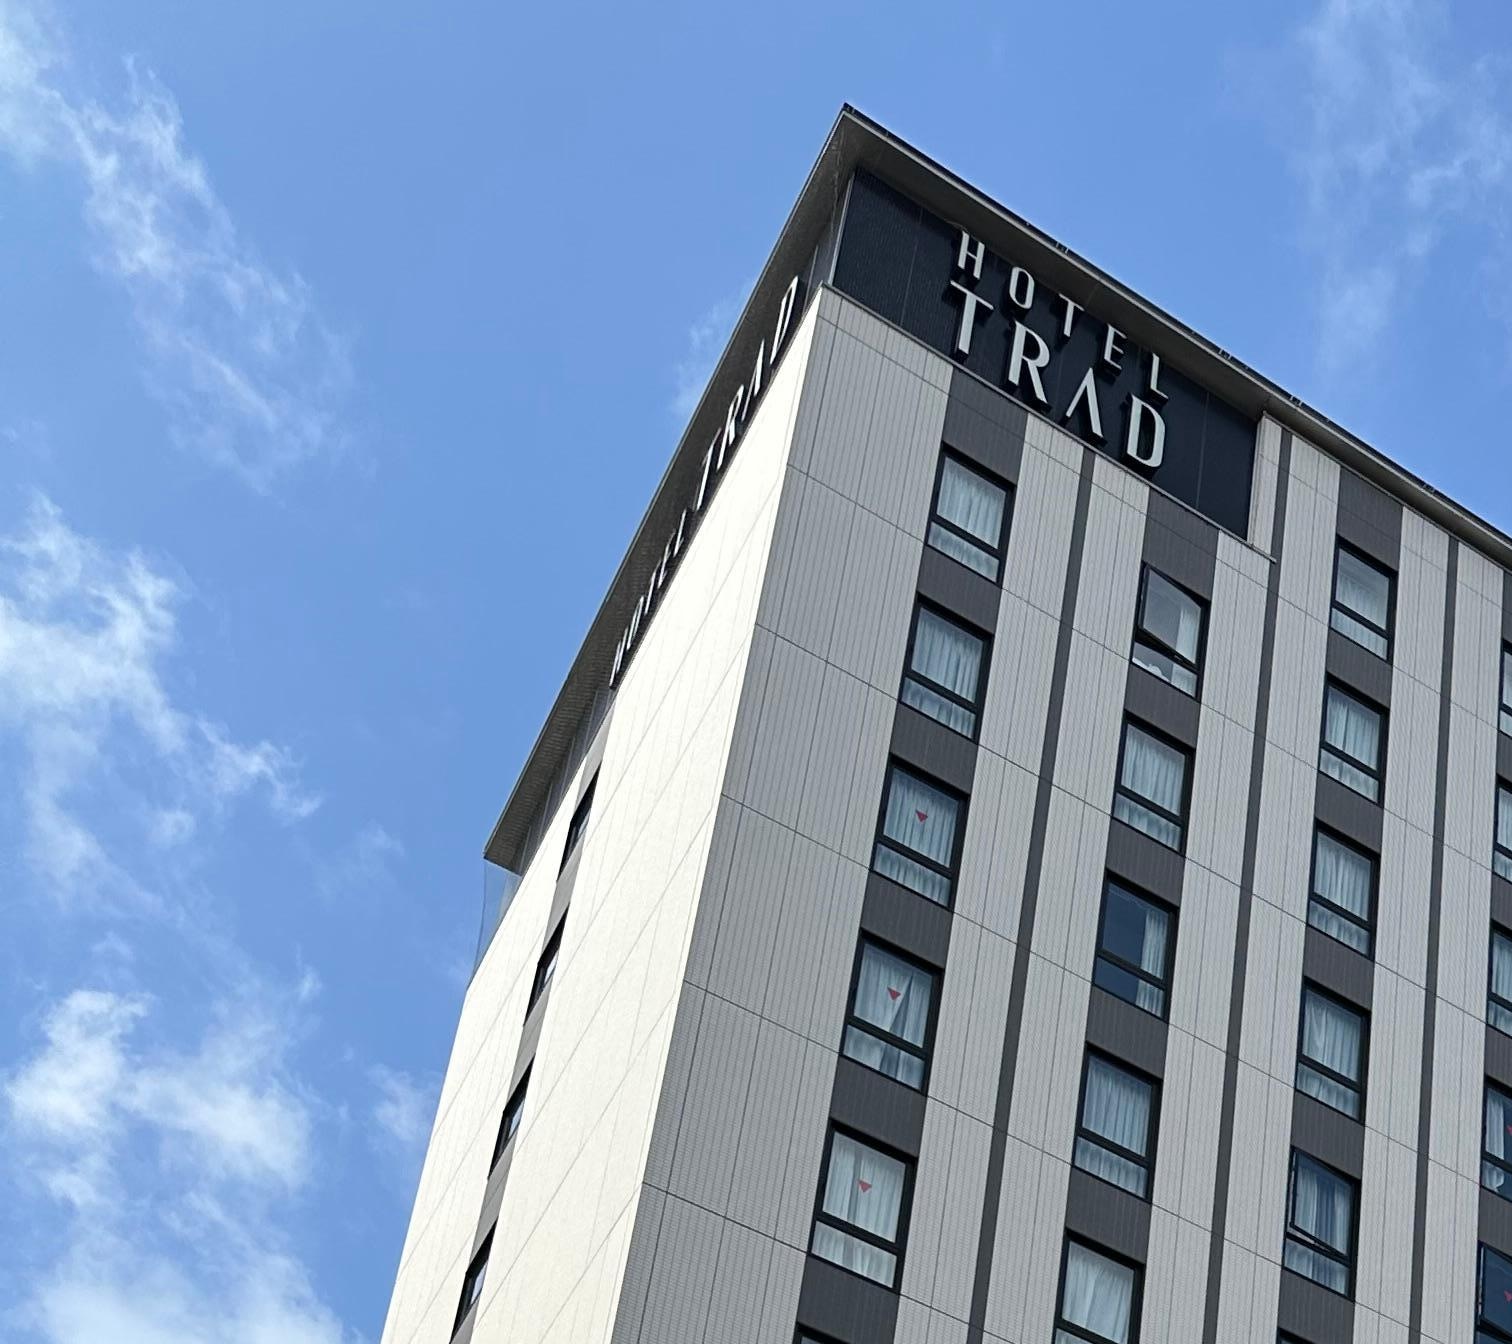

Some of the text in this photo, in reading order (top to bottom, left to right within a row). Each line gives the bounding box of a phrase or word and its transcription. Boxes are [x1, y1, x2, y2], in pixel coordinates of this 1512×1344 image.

[949, 279, 1167, 470] TRAD
[956, 229, 1169, 402] HOTEL
[608, 275, 801, 690] HOTEL TRAD
